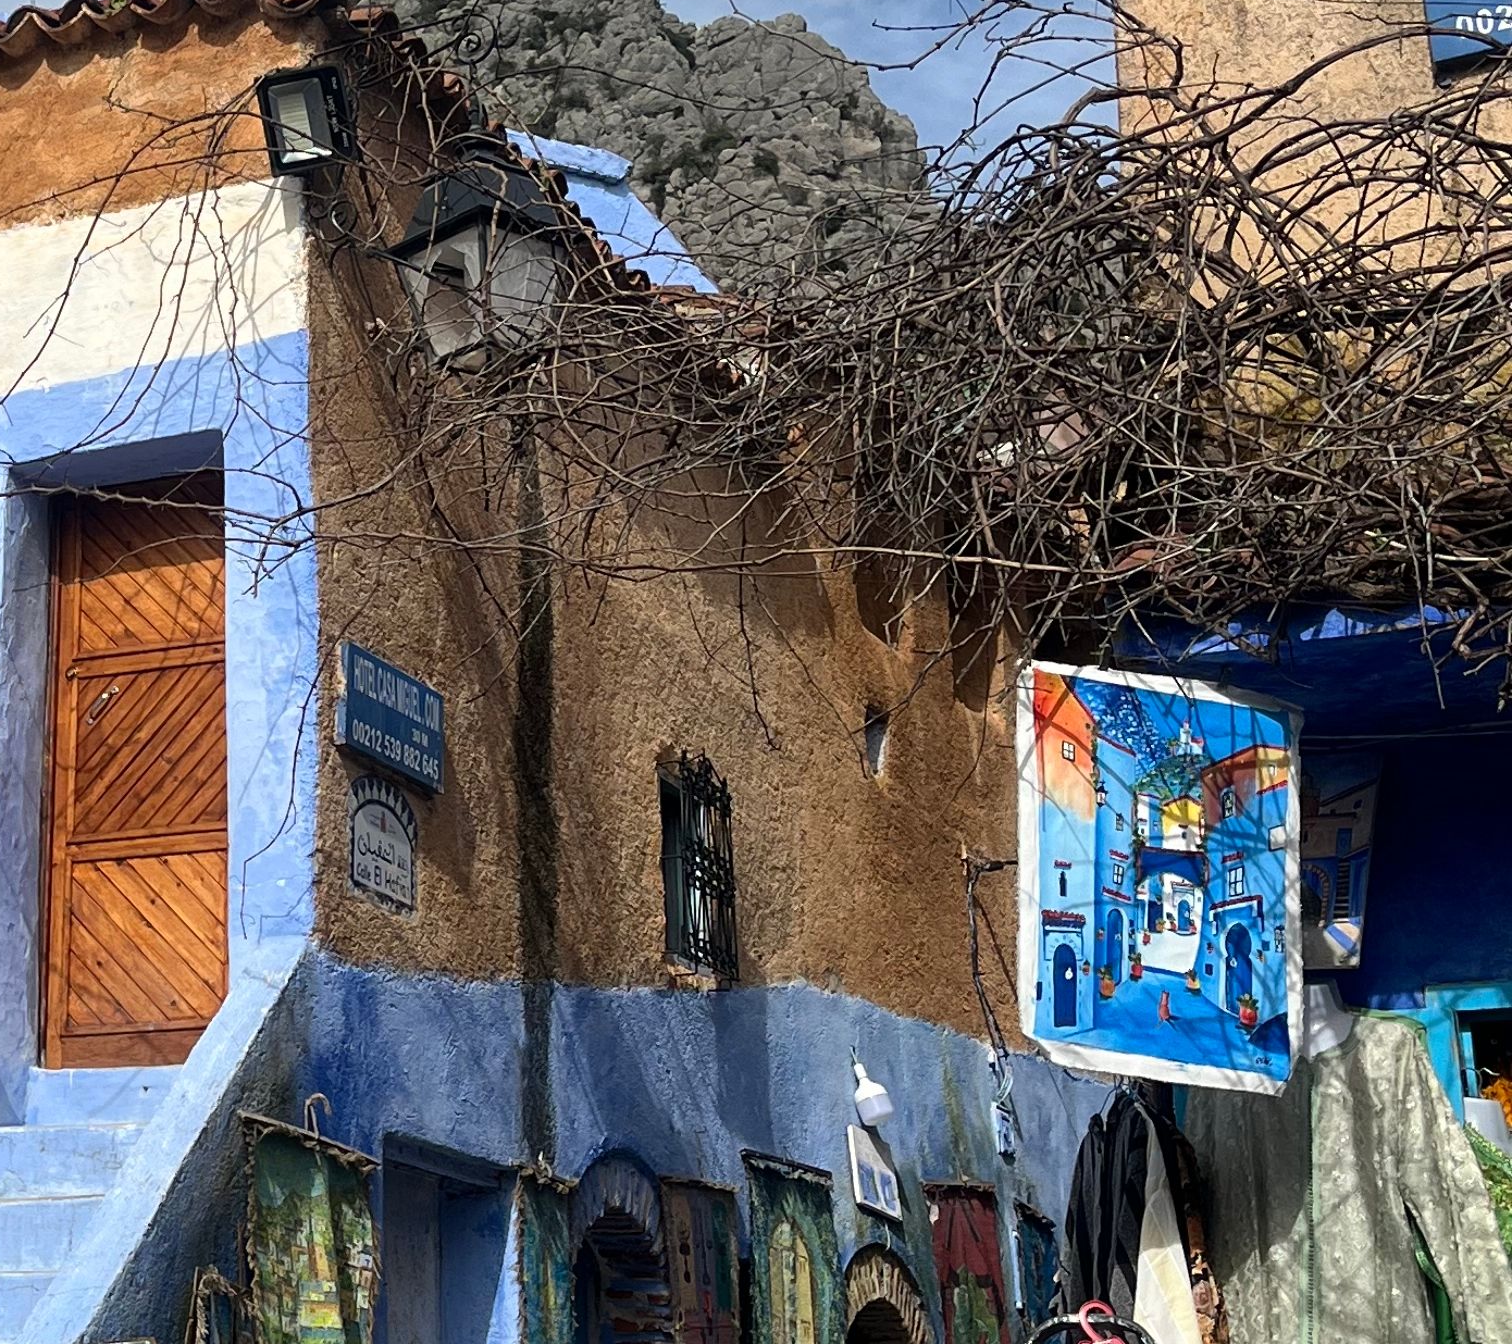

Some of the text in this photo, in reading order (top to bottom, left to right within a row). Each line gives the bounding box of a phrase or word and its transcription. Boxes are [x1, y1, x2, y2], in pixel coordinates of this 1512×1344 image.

[353, 655, 377, 700] HOTEL
[377, 666, 396, 710] CASA
[352, 719, 439, 780] 00212 539 882 645
[374, 865, 382, 886] El
